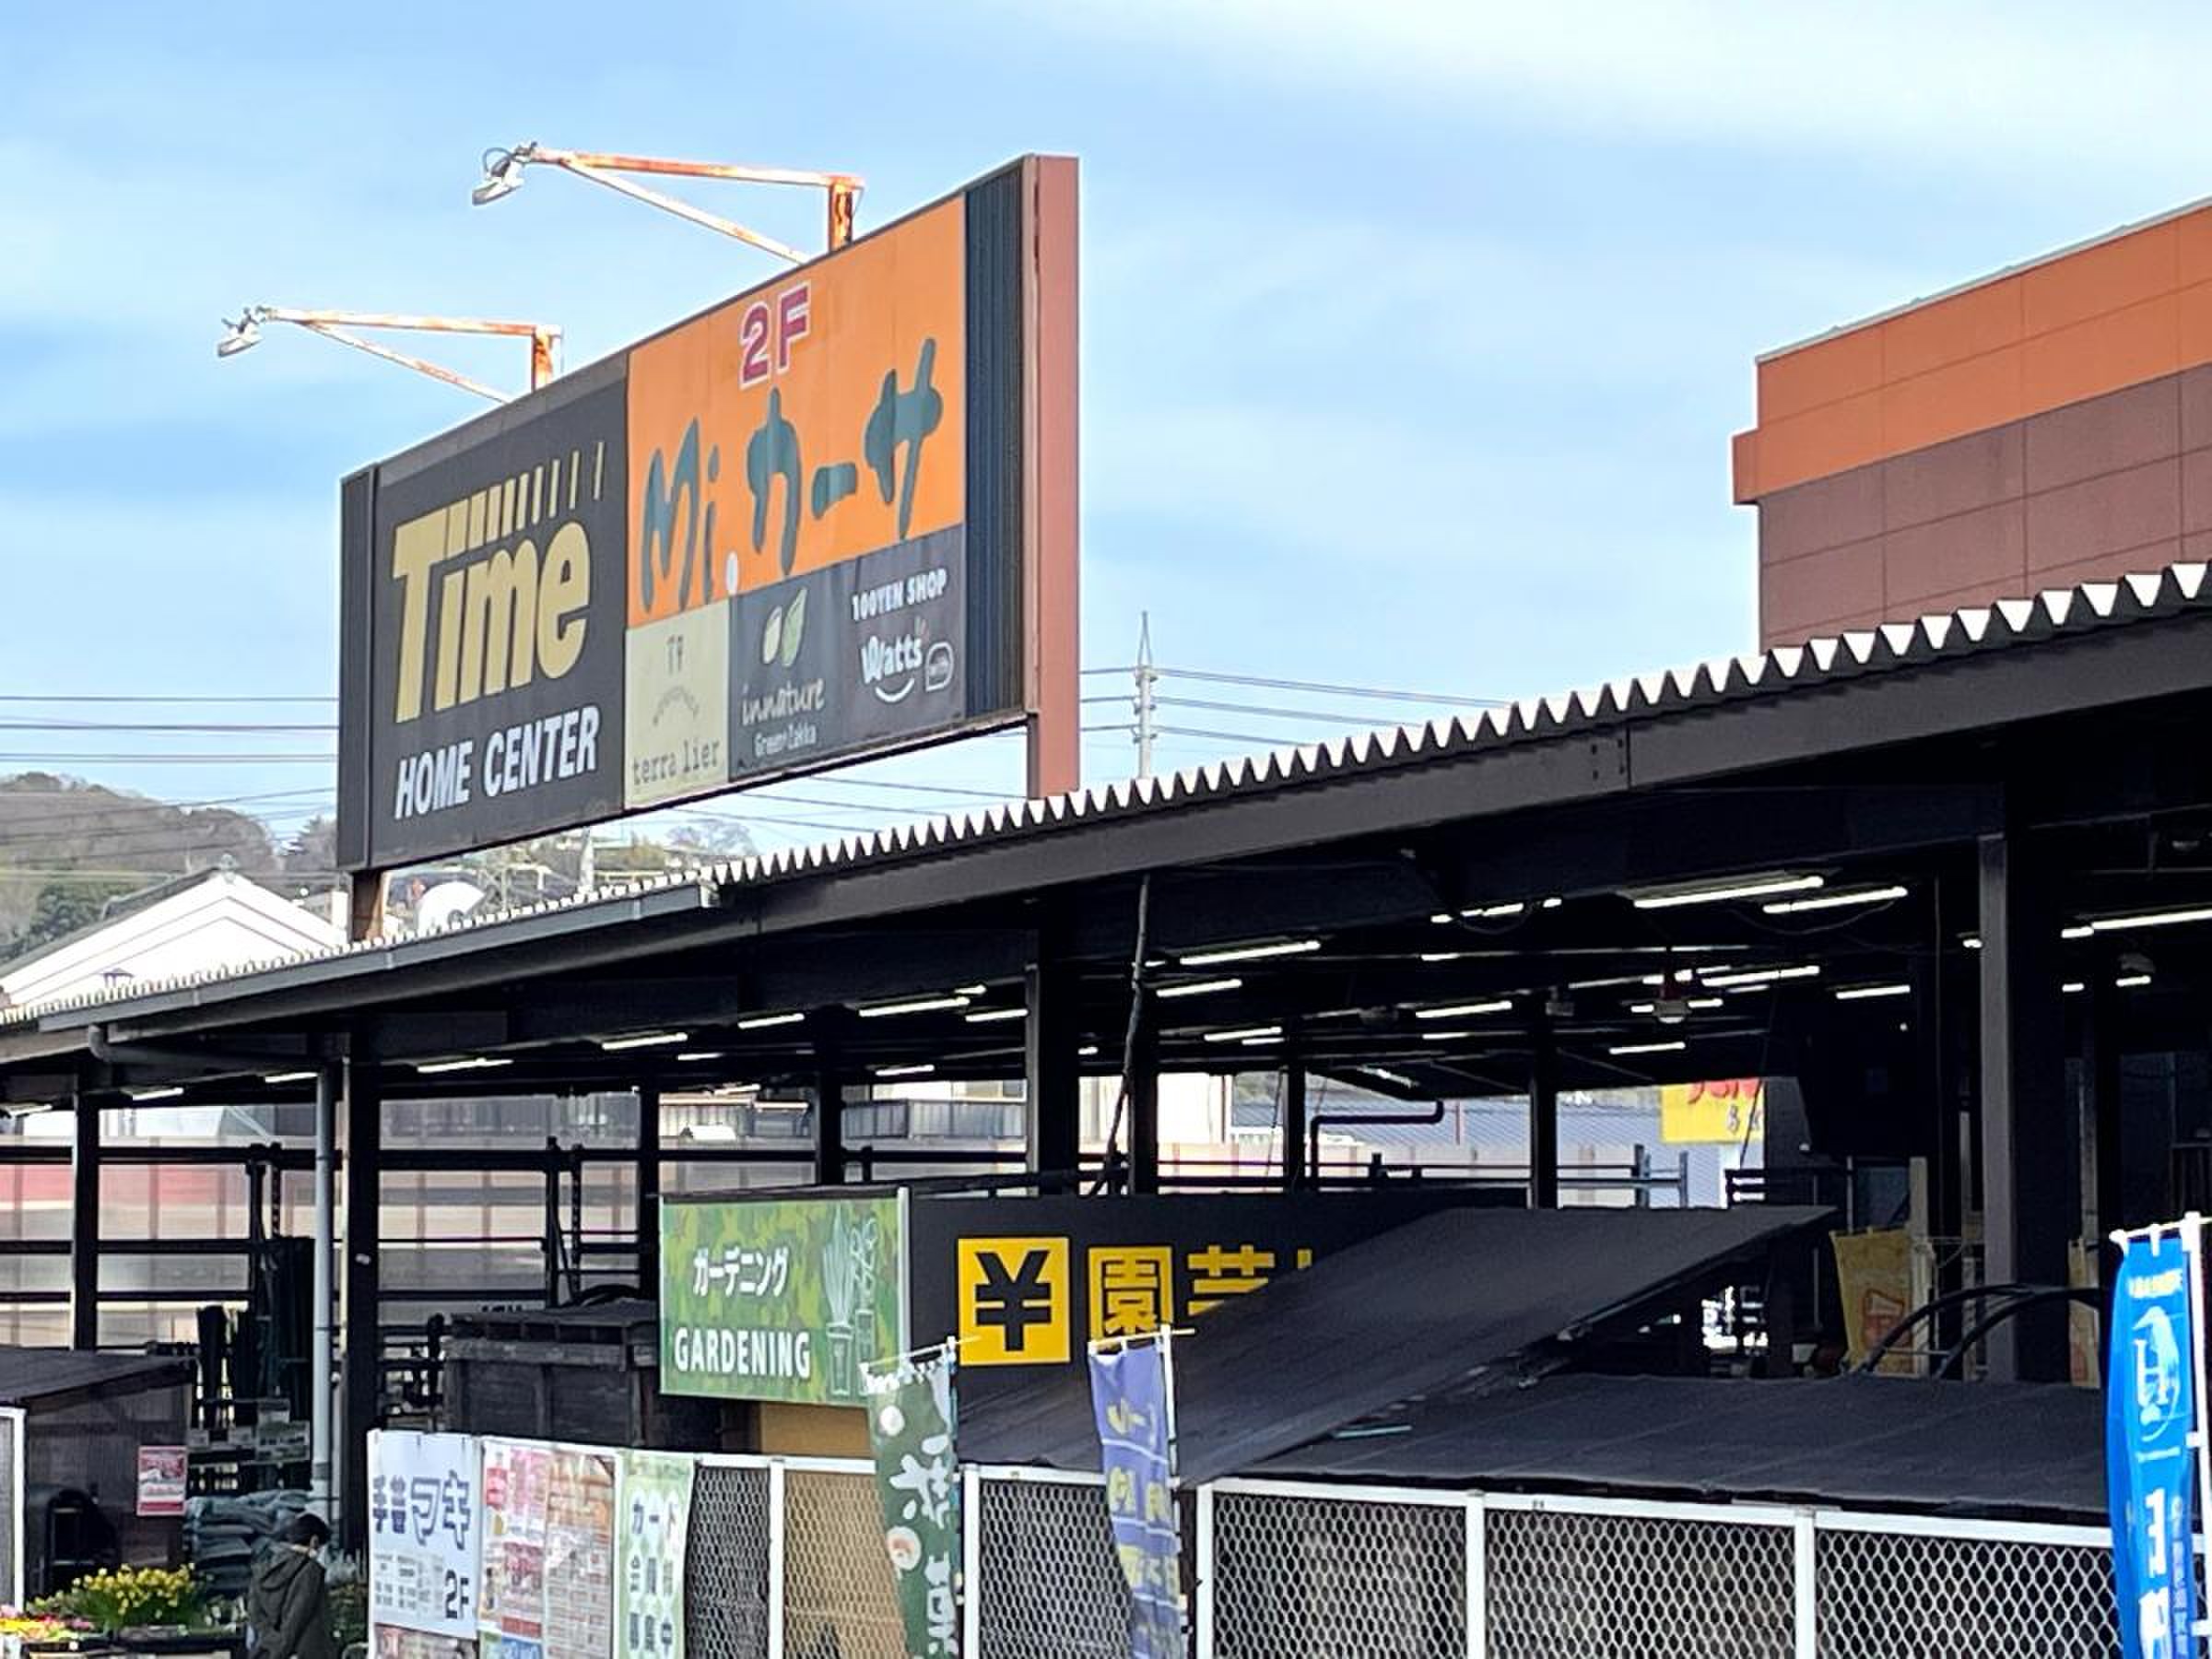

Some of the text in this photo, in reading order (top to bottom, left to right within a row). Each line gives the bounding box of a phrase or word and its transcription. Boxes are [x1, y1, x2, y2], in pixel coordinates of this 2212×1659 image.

[741, 280, 811, 389] 2F
[393, 502, 591, 724] Time
[852, 568, 947, 621] 100YEN SHOP
[861, 633, 923, 684] Watts
[394, 706, 601, 819] HOME CENTER
[692, 1247, 789, 1297] ガーデニング
[674, 1326, 811, 1379] GARDENING
[445, 1570, 469, 1620] 2F
